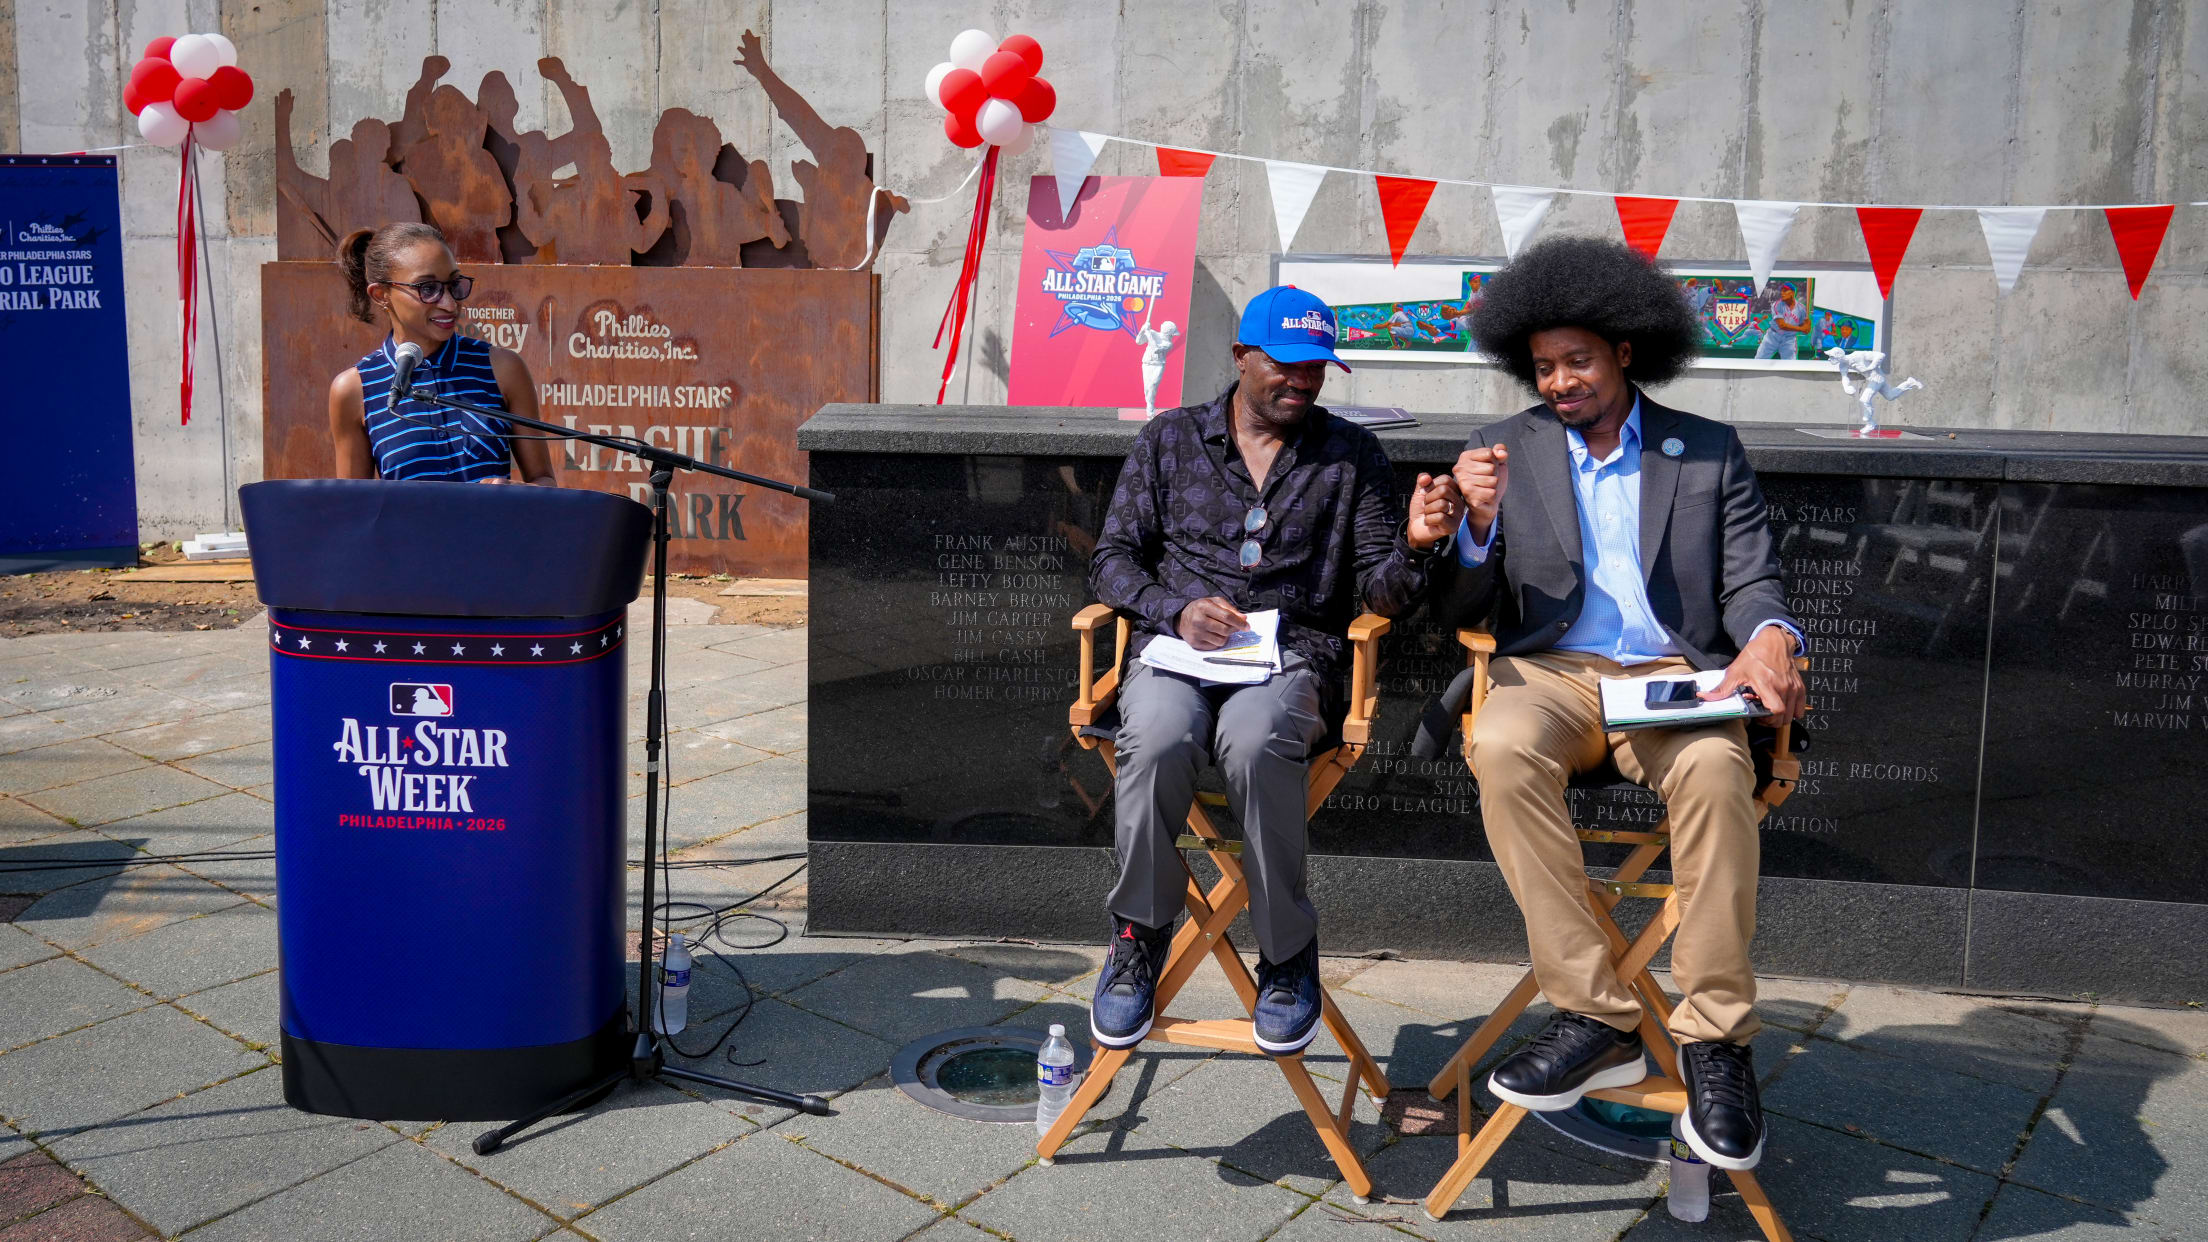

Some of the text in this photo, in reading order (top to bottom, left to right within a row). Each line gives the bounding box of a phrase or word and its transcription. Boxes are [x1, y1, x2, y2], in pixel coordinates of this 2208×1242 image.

[29, 223, 64, 234] Phillies
[8, 250, 66, 260] PHILADELPHIA
[66, 250, 92, 260] STARS
[19, 263, 94, 285] LEAGUE
[1042, 268, 1163, 296] ALL STAR GAME
[48, 287, 102, 309] PARK
[1058, 293, 1102, 301] PHILADELPHIA
[466, 307, 515, 320] TOGETHER
[1717, 316, 1746, 325] STARS
[594, 310, 672, 339] Phillies
[541, 384, 733, 409] PHILADELPHIA STARS
[562, 415, 734, 475] LEAGUE
[1798, 504, 1857, 523] STARS
[935, 534, 1068, 551] FRANK AUSTIN
[938, 554, 1064, 571] GENE BENSON
[1794, 557, 1863, 577] HARRIS
[938, 573, 1062, 590] LEFTY BOONE
[1790, 579, 1854, 596] JONES
[930, 591, 1071, 608] BARNEY BROWN
[1787, 598, 1842, 615] ONES
[2155, 594, 2198, 611] MILT
[947, 611, 1052, 627] JIM CARTER
[2128, 612, 2177, 630] SPLO
[951, 629, 1048, 646] JIM CASEY
[953, 649, 1047, 665] BILL CASH
[2135, 653, 2180, 670] PETE
[907, 666, 1080, 683] OSCAR CHARLESTO
[2116, 671, 2201, 691] MURRAY
[934, 684, 995, 700] HOMER
[1810, 677, 1858, 693] PALM
[2154, 693, 2191, 711] JIM
[2113, 711, 2191, 729] MARVIN
[333, 717, 509, 767] ALL STAR
[1849, 762, 1939, 783] RECORDS
[358, 765, 474, 813] WEEK
[1319, 794, 1471, 814] EGRO LEAGUE
[339, 814, 507, 831] PHILADELPHIA 2026
